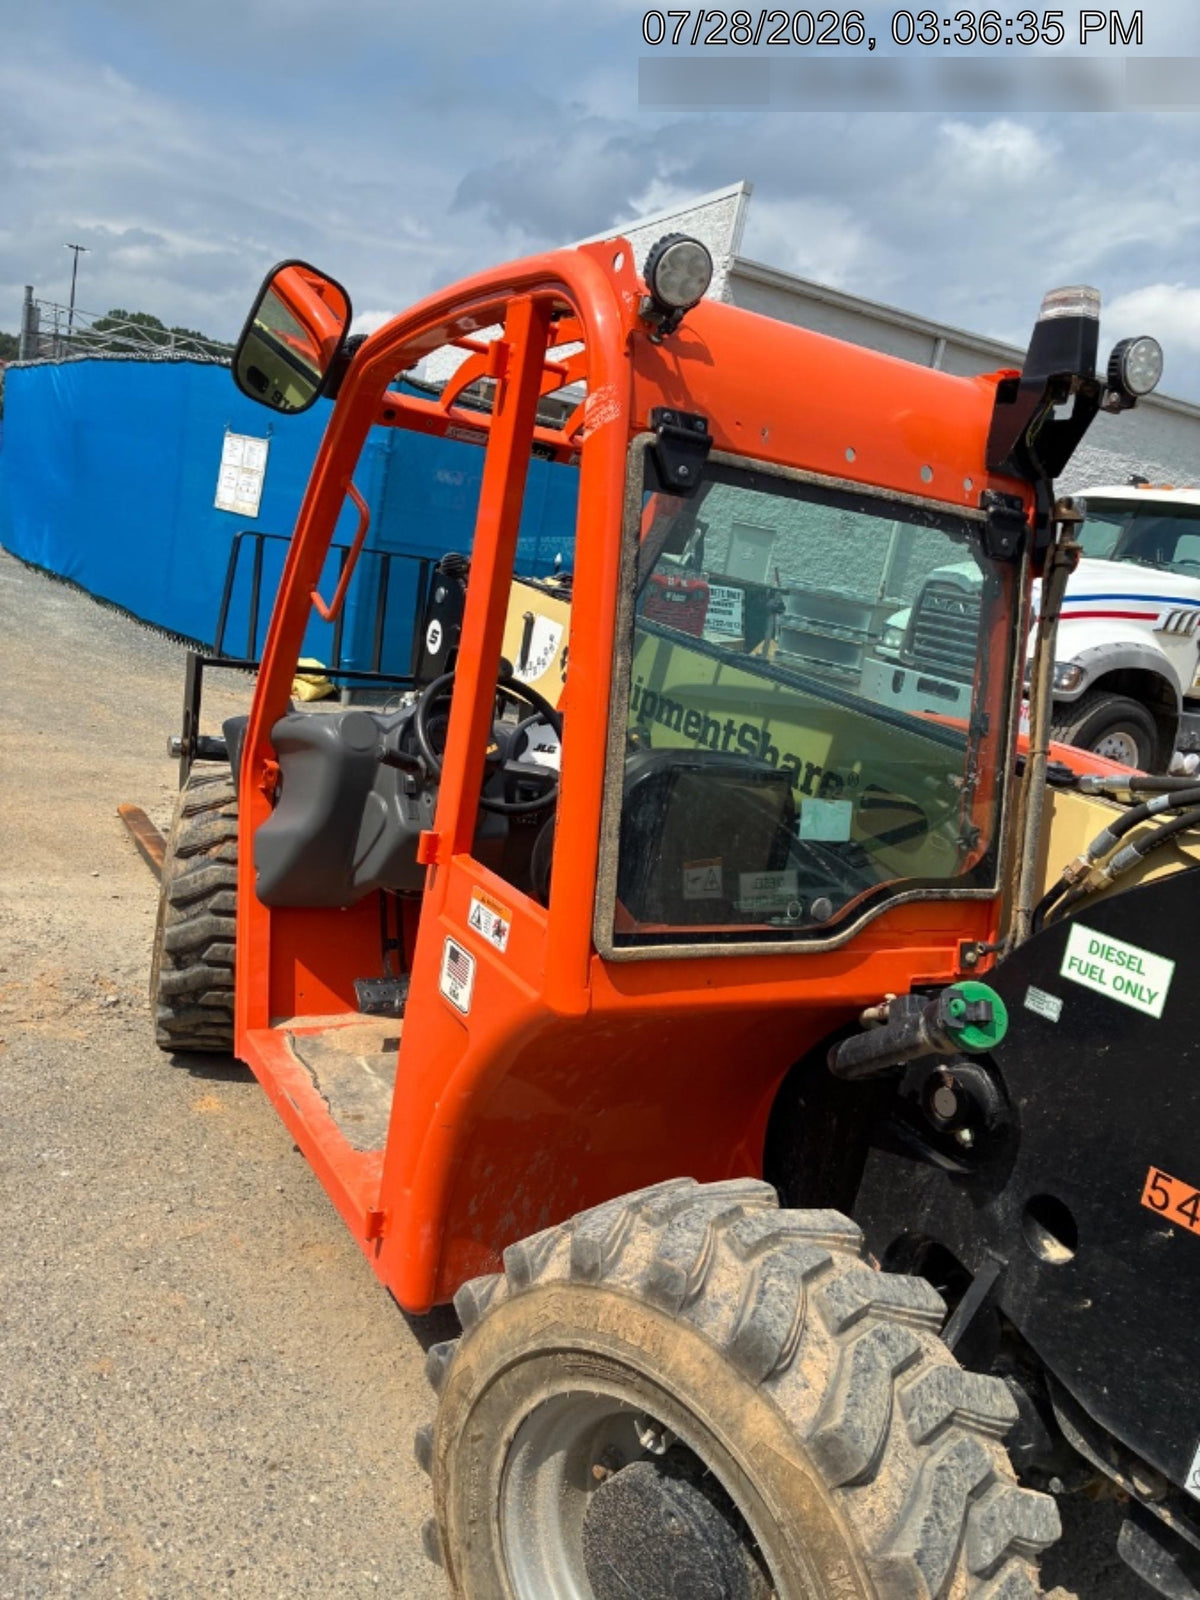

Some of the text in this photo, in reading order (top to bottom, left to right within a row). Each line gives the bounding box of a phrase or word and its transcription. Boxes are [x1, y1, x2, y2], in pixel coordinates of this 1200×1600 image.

[533, 743, 557, 754] JLG
[1088, 940, 1145, 976] DIESEL
[1068, 956, 1158, 1005] FUEL ONLY
